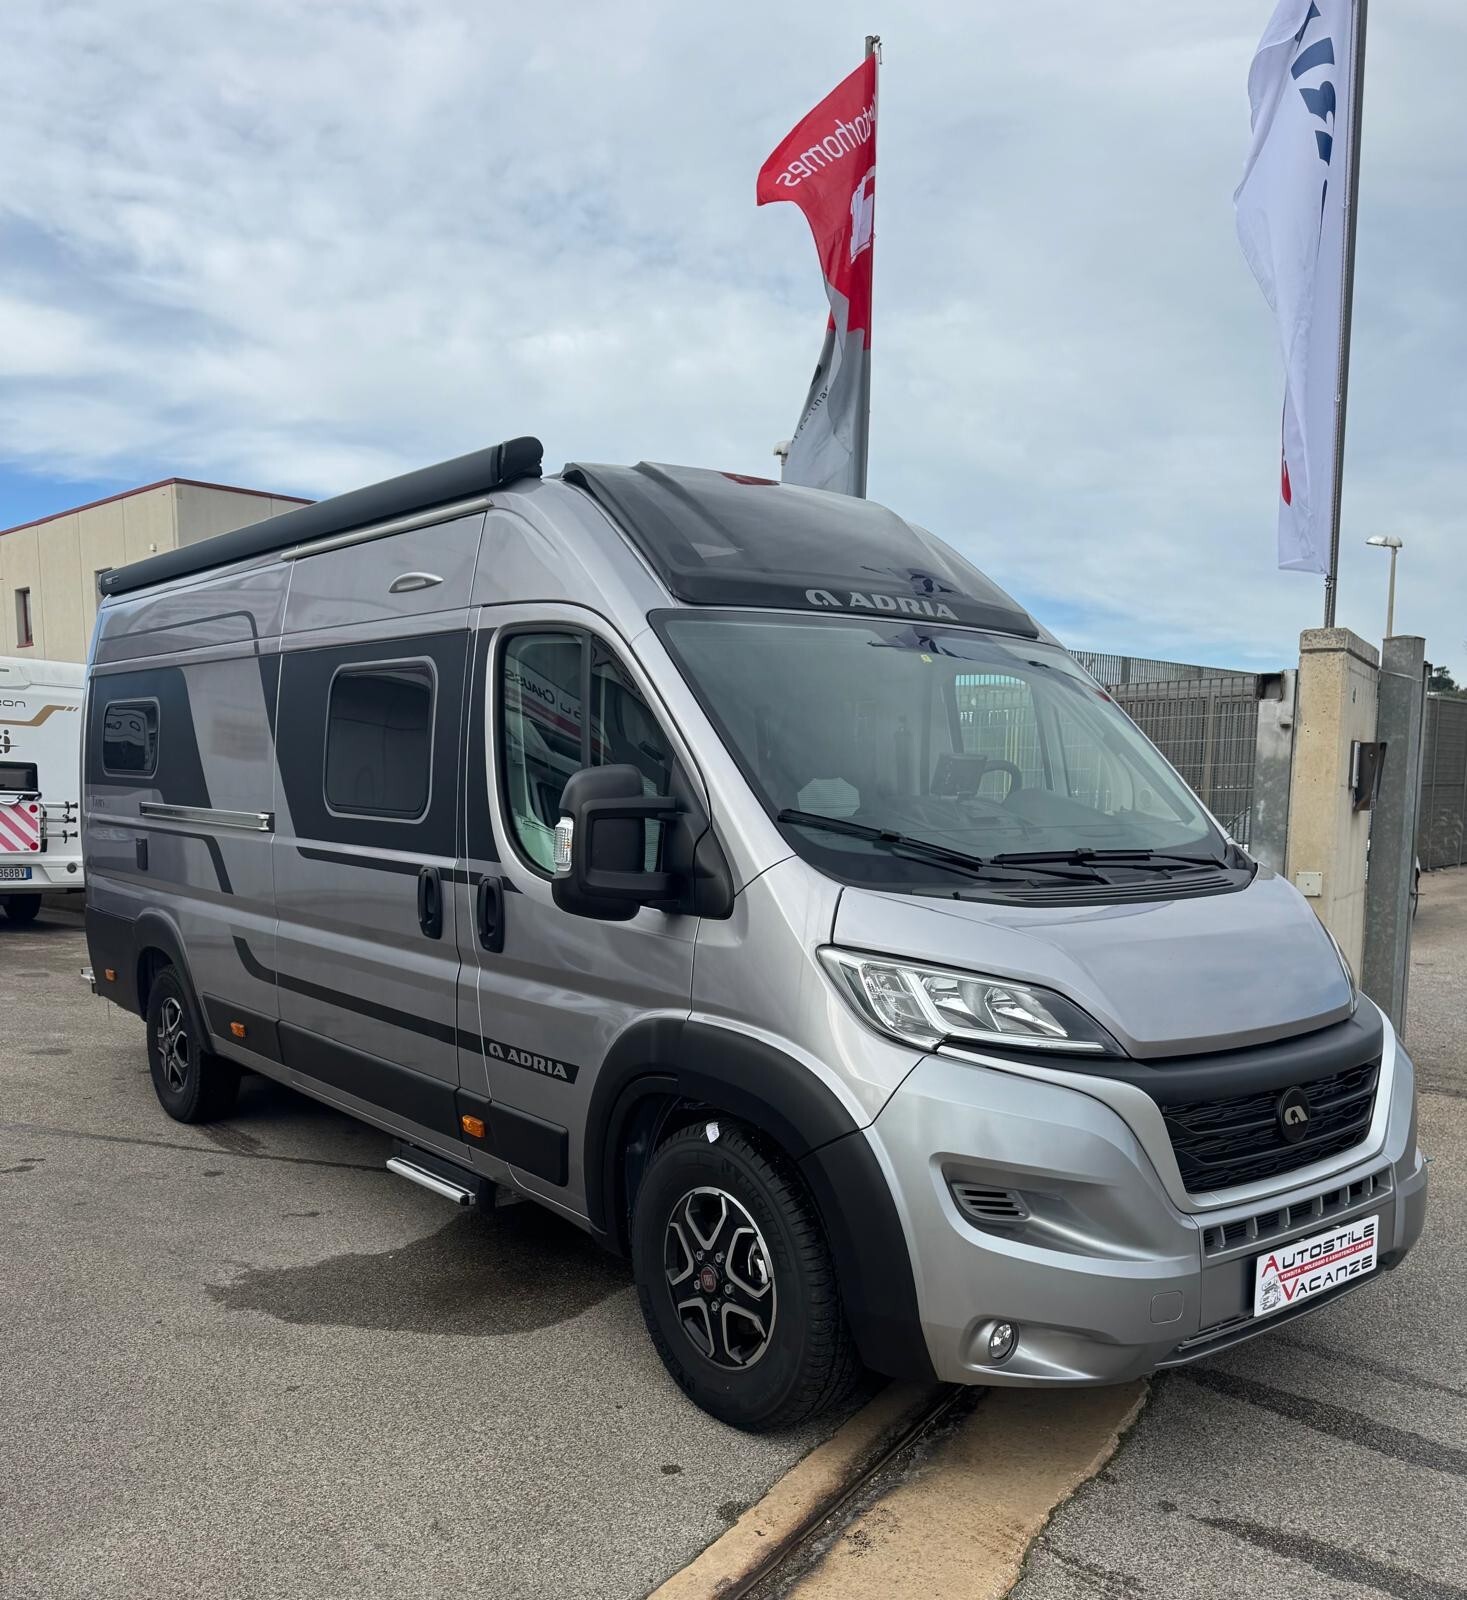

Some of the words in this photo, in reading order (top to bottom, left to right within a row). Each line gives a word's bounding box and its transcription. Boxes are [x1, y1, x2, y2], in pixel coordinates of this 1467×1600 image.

[849, 591, 960, 621] ADRIA
[507, 1048, 568, 1079] ADRIA
[1282, 1254, 1373, 1301] VACANZE
